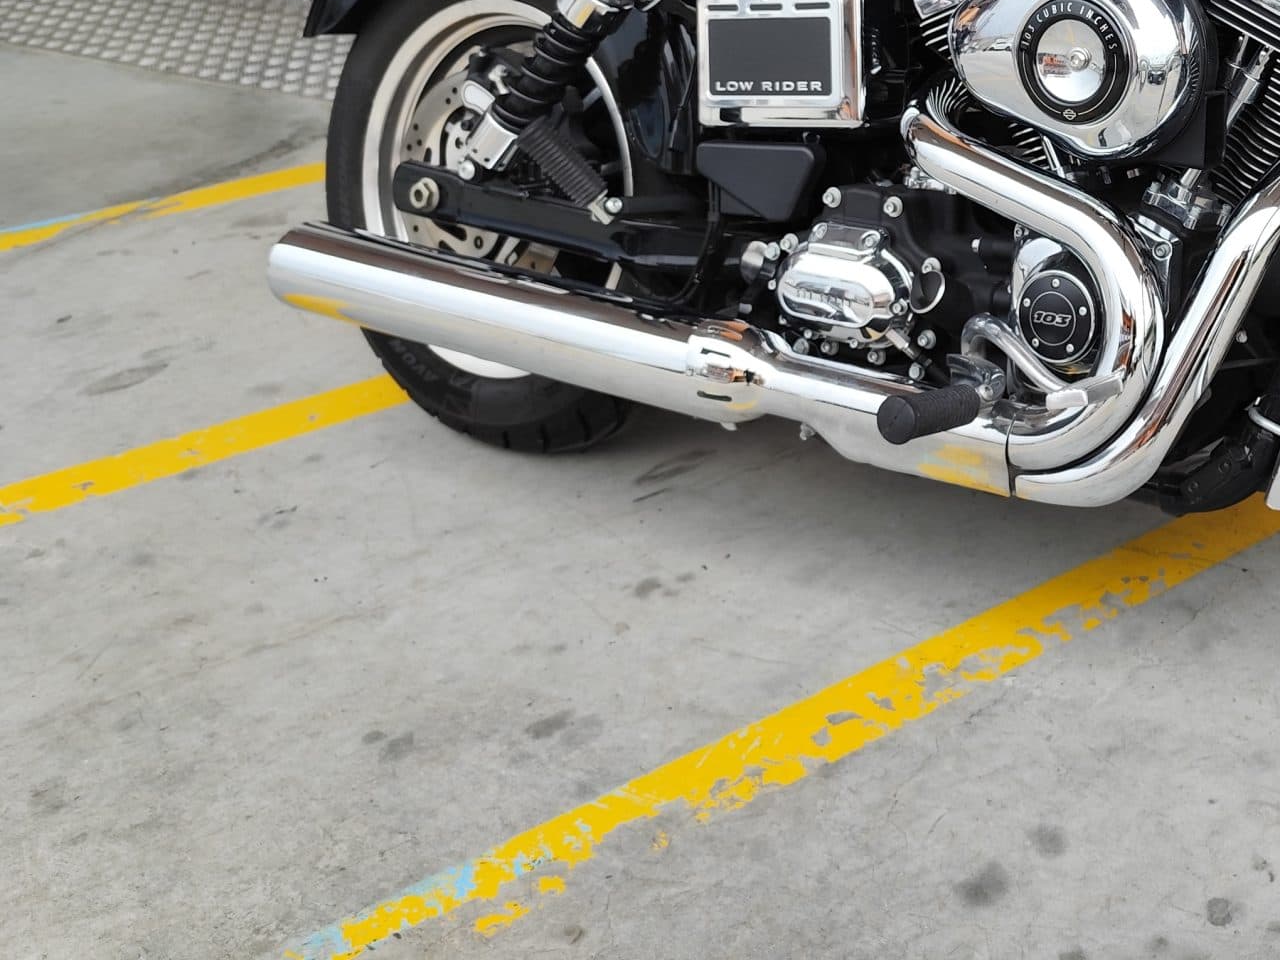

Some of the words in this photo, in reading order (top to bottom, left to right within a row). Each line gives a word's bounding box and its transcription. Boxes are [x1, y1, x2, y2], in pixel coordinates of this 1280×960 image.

[1021, 24, 1035, 47] 103
[1036, 2, 1073, 23] CUBIC
[1080, 5, 1118, 50] INCHES
[715, 81, 754, 92] LOW
[761, 81, 823, 92] RIDER
[1033, 310, 1072, 328] 103
